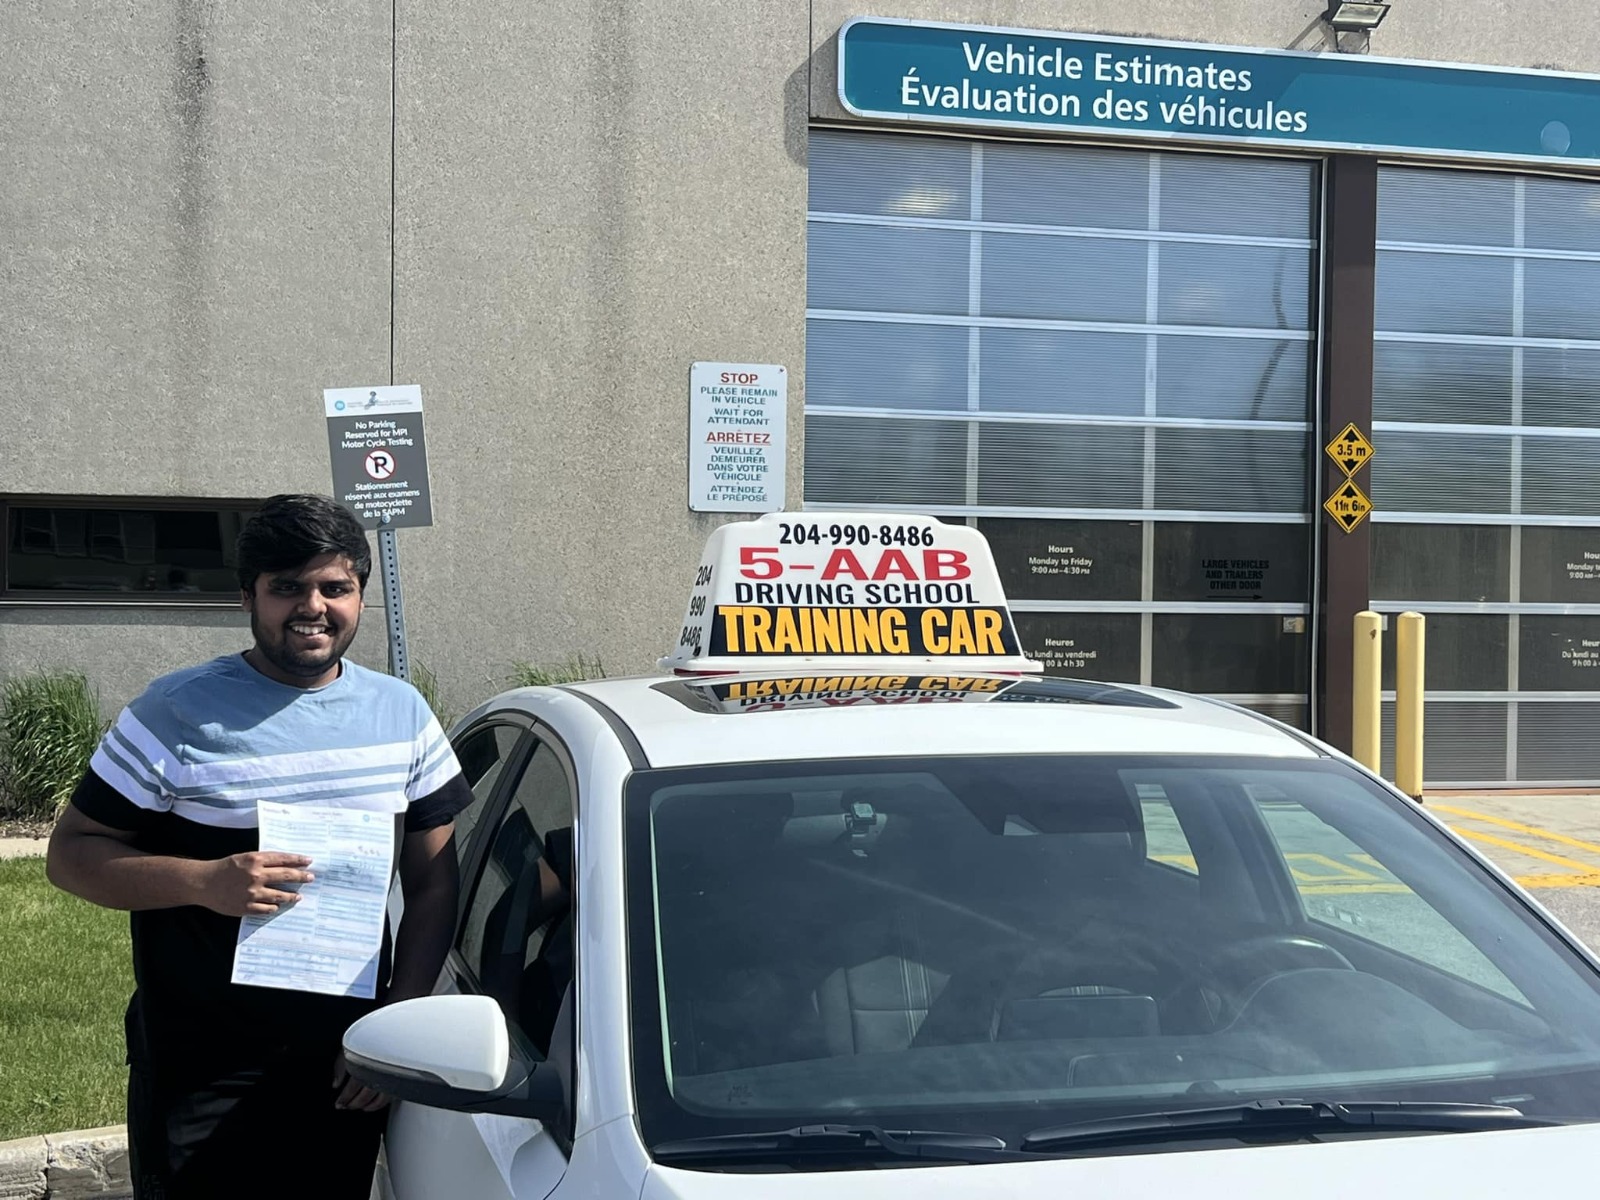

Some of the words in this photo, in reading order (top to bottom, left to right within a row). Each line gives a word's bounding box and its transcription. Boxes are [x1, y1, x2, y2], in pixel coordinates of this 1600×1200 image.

[962, 42, 1083, 79] Vehicle
[1095, 52, 1252, 91] Estimates
[901, 67, 1080, 117] Évaluation
[1092, 89, 1149, 121] des
[1159, 94, 1308, 132] véhicules
[720, 372, 758, 384] STOP
[701, 386, 738, 395] PLEASE
[741, 388, 778, 397] REMAIN
[725, 396, 766, 405] VEHICLE
[714, 408, 740, 416] WAIT
[743, 409, 764, 417] FOR
[355, 421, 368, 430] No
[368, 420, 396, 430] Parking
[707, 416, 770, 425] ATTENDANT
[345, 430, 379, 440] Reserved
[380, 429, 391, 438] for
[392, 428, 408, 436] MPI
[706, 429, 771, 444] ARRÊTEZ
[341, 440, 365, 449] Motor
[366, 439, 386, 448] Cycle
[387, 437, 414, 447] Testing
[714, 446, 763, 455] VEUILLEZ
[1337, 444, 1353, 456] 3.5
[1356, 446, 1366, 457] m
[711, 455, 766, 464] DEMEURER
[707, 464, 733, 472] DANS
[736, 464, 769, 473] VOTRE
[714, 471, 762, 481] VÉHICULE
[354, 481, 408, 491] Stationnement
[710, 485, 764, 494] ATTENDEZ
[344, 492, 372, 501] réservé
[388, 490, 420, 499] examens
[722, 493, 768, 502] PRÉPOSÉ
[354, 501, 364, 509] de
[365, 498, 413, 509] motocyclette
[363, 510, 373, 518] de
[374, 509, 381, 517] la
[779, 523, 935, 547] 204-990-8486
[1048, 544, 1074, 554] Hours
[1584, 551, 1600, 559] Hou
[739, 547, 972, 581] 5-AAB
[1028, 557, 1059, 567] Monday
[1070, 557, 1093, 567] Friday
[1202, 559, 1228, 569] LARGE
[1231, 560, 1270, 569] VEHICLES
[1566, 562, 1594, 572] Monday
[695, 564, 713, 586] 204
[1031, 566, 1048, 574] 9:00
[1205, 570, 1222, 579] AND
[1225, 570, 1264, 579] TRAILERS
[1210, 580, 1237, 590] OTHER
[1239, 580, 1262, 590] DOOR
[735, 582, 854, 604] DRIVING
[865, 582, 980, 604] SCHOOL
[690, 595, 706, 616] 990
[718, 606, 909, 655] TRAINING
[920, 607, 1006, 655] CAR
[680, 625, 702, 647] 8486
[1045, 638, 1075, 647] Heures
[1582, 639, 1600, 647] Heur
[1035, 650, 1053, 658] lundi
[1065, 650, 1097, 659] vendredi
